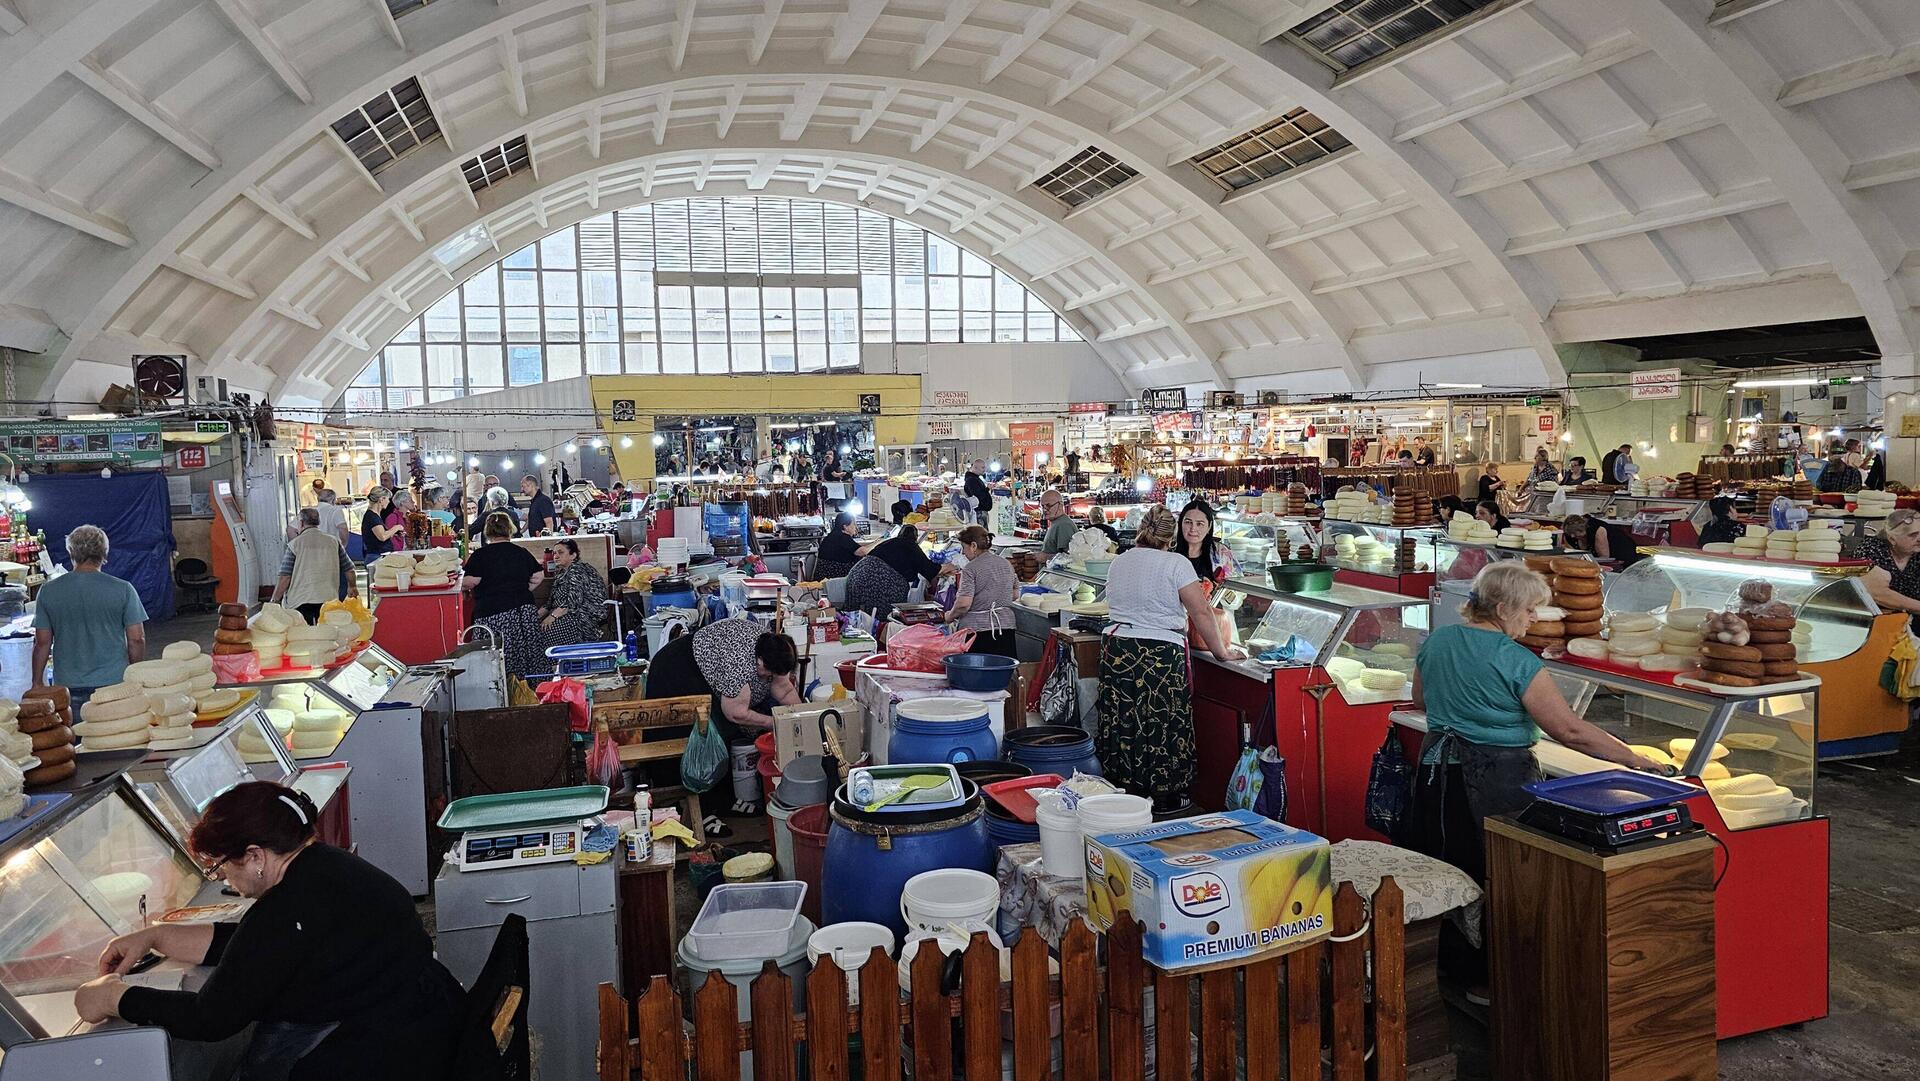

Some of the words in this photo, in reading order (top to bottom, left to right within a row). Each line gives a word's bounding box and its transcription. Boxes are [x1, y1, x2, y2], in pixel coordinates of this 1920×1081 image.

[1154, 390, 1182, 409] ხორცი
[1540, 417, 1552, 425] 112
[183, 450, 202, 459] 112
[1182, 880, 1221, 902] Dole
[1184, 932, 1257, 959] PREMIUM
[1261, 914, 1323, 944] BANANAS
